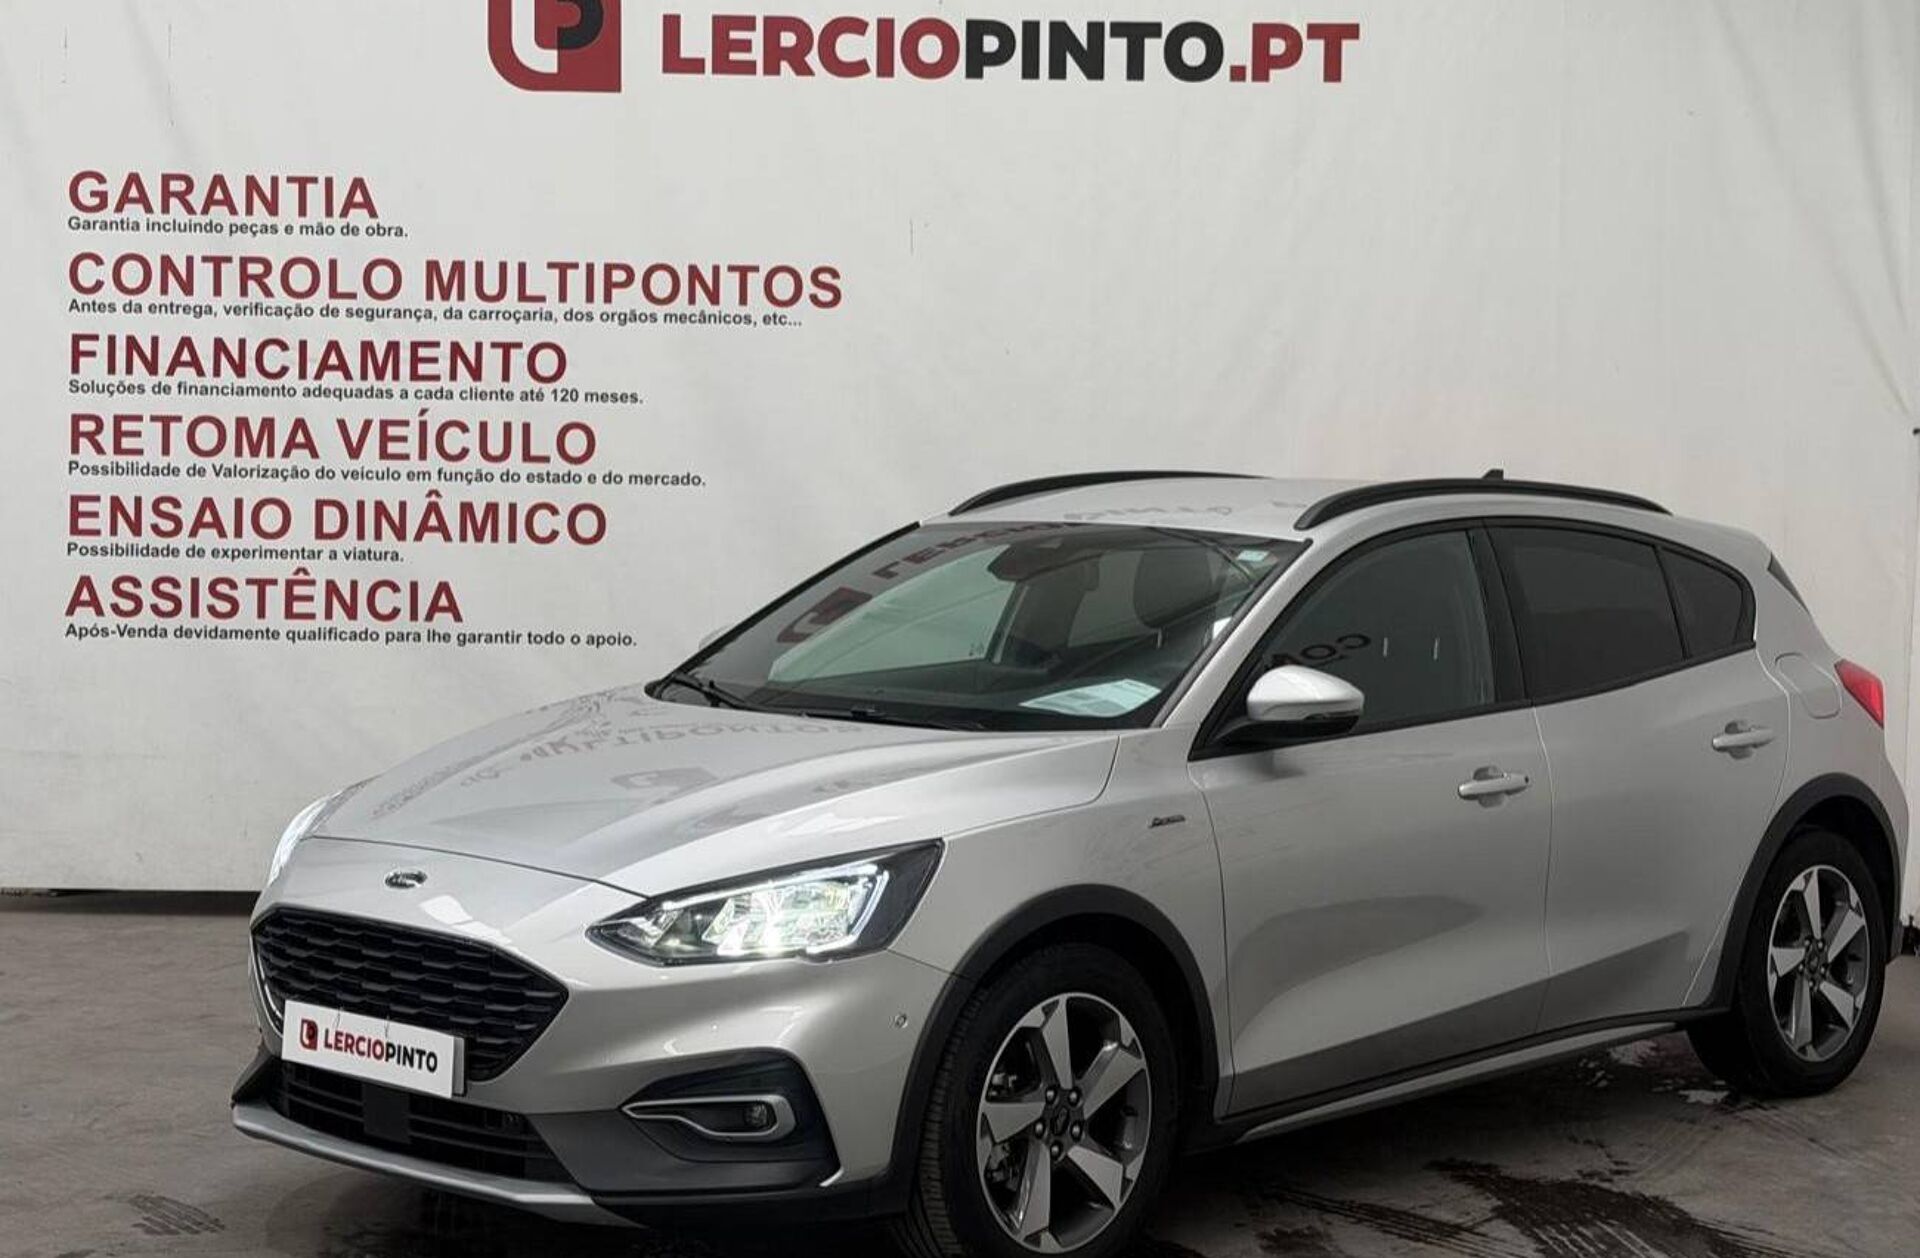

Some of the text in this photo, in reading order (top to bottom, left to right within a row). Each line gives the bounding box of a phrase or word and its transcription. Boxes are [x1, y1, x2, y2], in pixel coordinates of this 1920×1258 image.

[662, 13, 1360, 83] LERCIOPINTO.PT
[69, 170, 378, 219] GARANTIA
[67, 216, 409, 237] Garantia incluindo peças e mão de obra.
[69, 252, 842, 309] CONTROLO MULTIPONTOS
[68, 298, 118, 313] Antes
[121, 300, 143, 314] da
[147, 301, 218, 319] entrega,
[222, 302, 315, 320] verificação
[319, 304, 341, 318] de
[344, 307, 438, 322] segurança,
[442, 306, 464, 320] da
[467, 307, 558, 324] carroçaria,
[563, 308, 595, 322] dos
[663, 310, 758, 327] mecânicos,
[762, 312, 802, 326] etc...
[71, 333, 566, 384] FINANCIAMENTO
[68, 379, 644, 404] Soluções de financiamento adequadas a cada cliente até 120 meses.
[71, 408, 596, 465] RETOMA VEÍCULO
[68, 460, 181, 477] Possibilidade
[185, 463, 207, 477] de
[211, 463, 311, 482] Valorização
[314, 466, 337, 480] do
[405, 470, 432, 481] em
[436, 467, 495, 485] função
[499, 469, 522, 483] do
[525, 470, 583, 484] estado
[587, 473, 597, 484] e
[601, 470, 624, 484] do
[628, 472, 706, 486] mercado.
[70, 489, 606, 545] ENSAIO DINÂMICO
[66, 542, 404, 562] Possibilidade de experimentar a viatura.
[65, 567, 463, 623] ASSISTÊNCIA
[64, 623, 637, 649] Após-Venda devidamente qualificado para lhe garantir todo o apoio.
[324, 1028, 438, 1073] LERCIOPINTO
